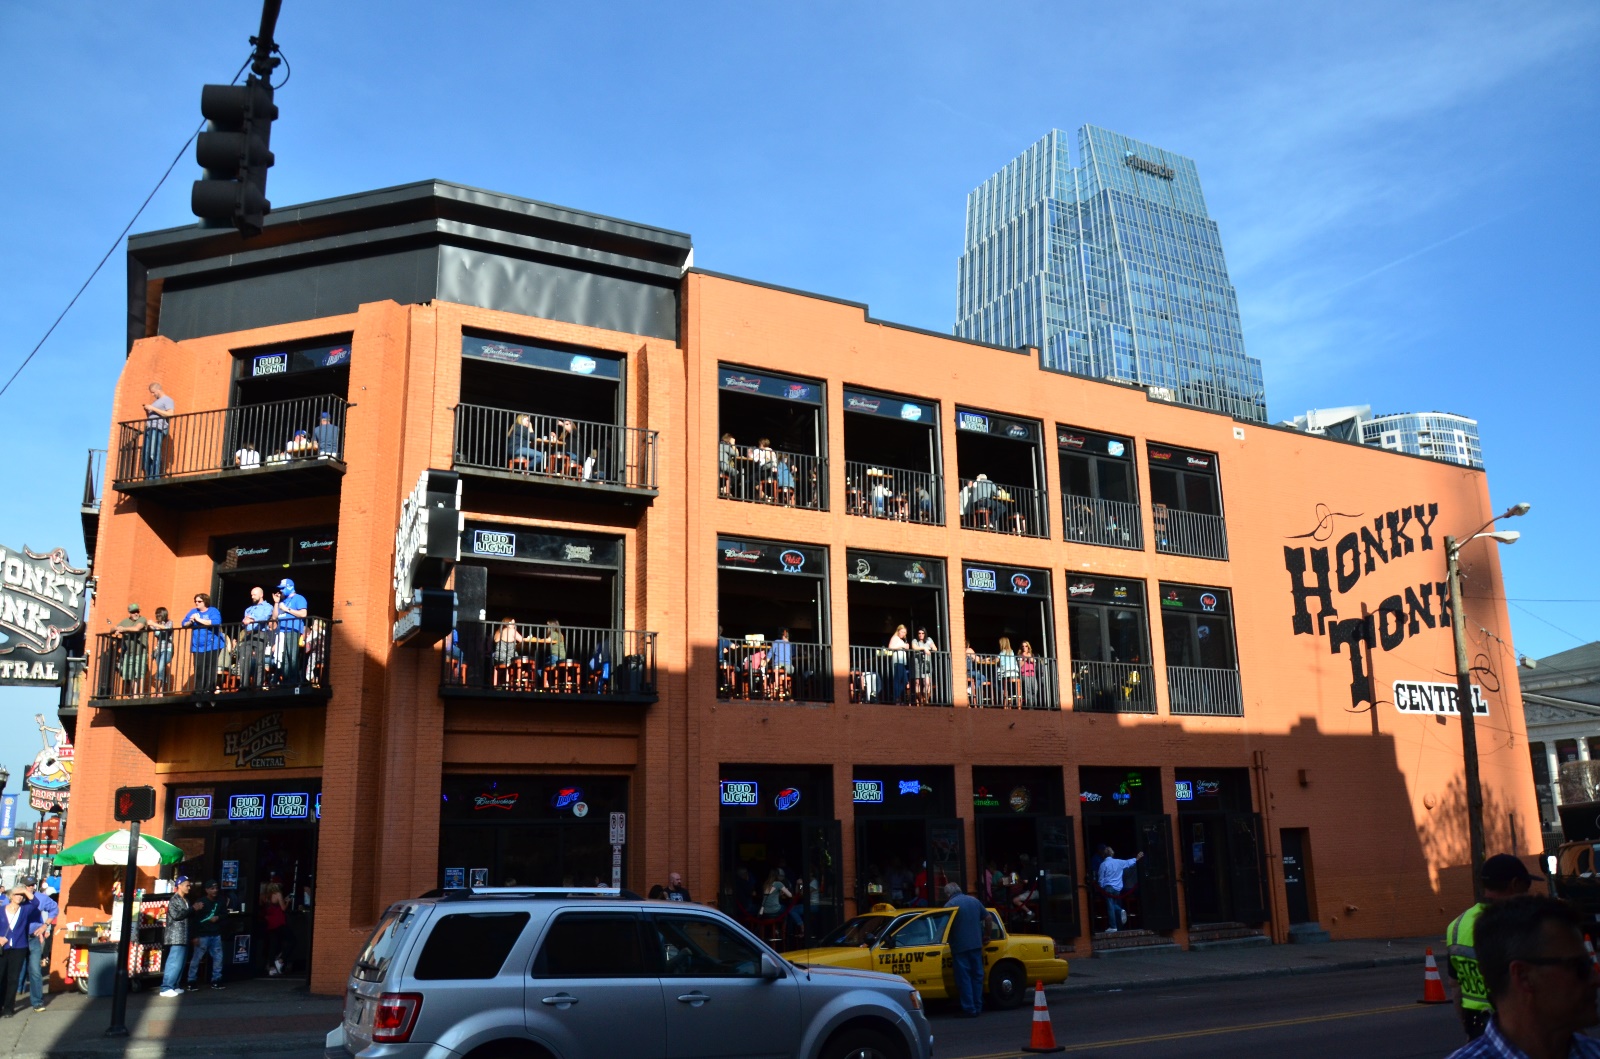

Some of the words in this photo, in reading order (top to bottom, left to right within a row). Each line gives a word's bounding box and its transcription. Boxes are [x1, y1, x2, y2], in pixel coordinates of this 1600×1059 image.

[259, 356, 281, 367] BUD
[255, 363, 285, 375] LIGHT
[965, 414, 983, 424] BUD
[960, 421, 987, 432] IGHT
[481, 533, 509, 543] BUD
[475, 542, 514, 554] LIGHT
[1283, 502, 1438, 636] HONKY
[0, 549, 84, 609] ONKY
[972, 571, 991, 580] BUD
[968, 578, 994, 588] LIGHT
[0, 593, 51, 639] NK
[1328, 582, 1464, 708] TONK
[0, 659, 59, 680] TRAL
[1395, 683, 1488, 713] CENTRL
[225, 712, 283, 755] HONKY
[236, 730, 287, 767] TONK
[251, 757, 285, 768] CENTRAL
[727, 784, 752, 794] BUD
[855, 782, 878, 792] BUD
[723, 792, 756, 803] LIGHT
[852, 790, 882, 801] LIGHT
[1175, 790, 1191, 799] GHT
[182, 797, 206, 807] BUD
[235, 797, 260, 807] BUD
[277, 795, 302, 806] BUD
[475, 796, 517, 805] Budweiser
[178, 806, 210, 818] LIGHT
[231, 806, 263, 818] LIGHT
[273, 805, 306, 816] LIGHT
[878, 952, 925, 965] YELLOW
[892, 963, 911, 974] CAB
[1458, 959, 1480, 976] ETR
[1459, 977, 1486, 995] OLIC
